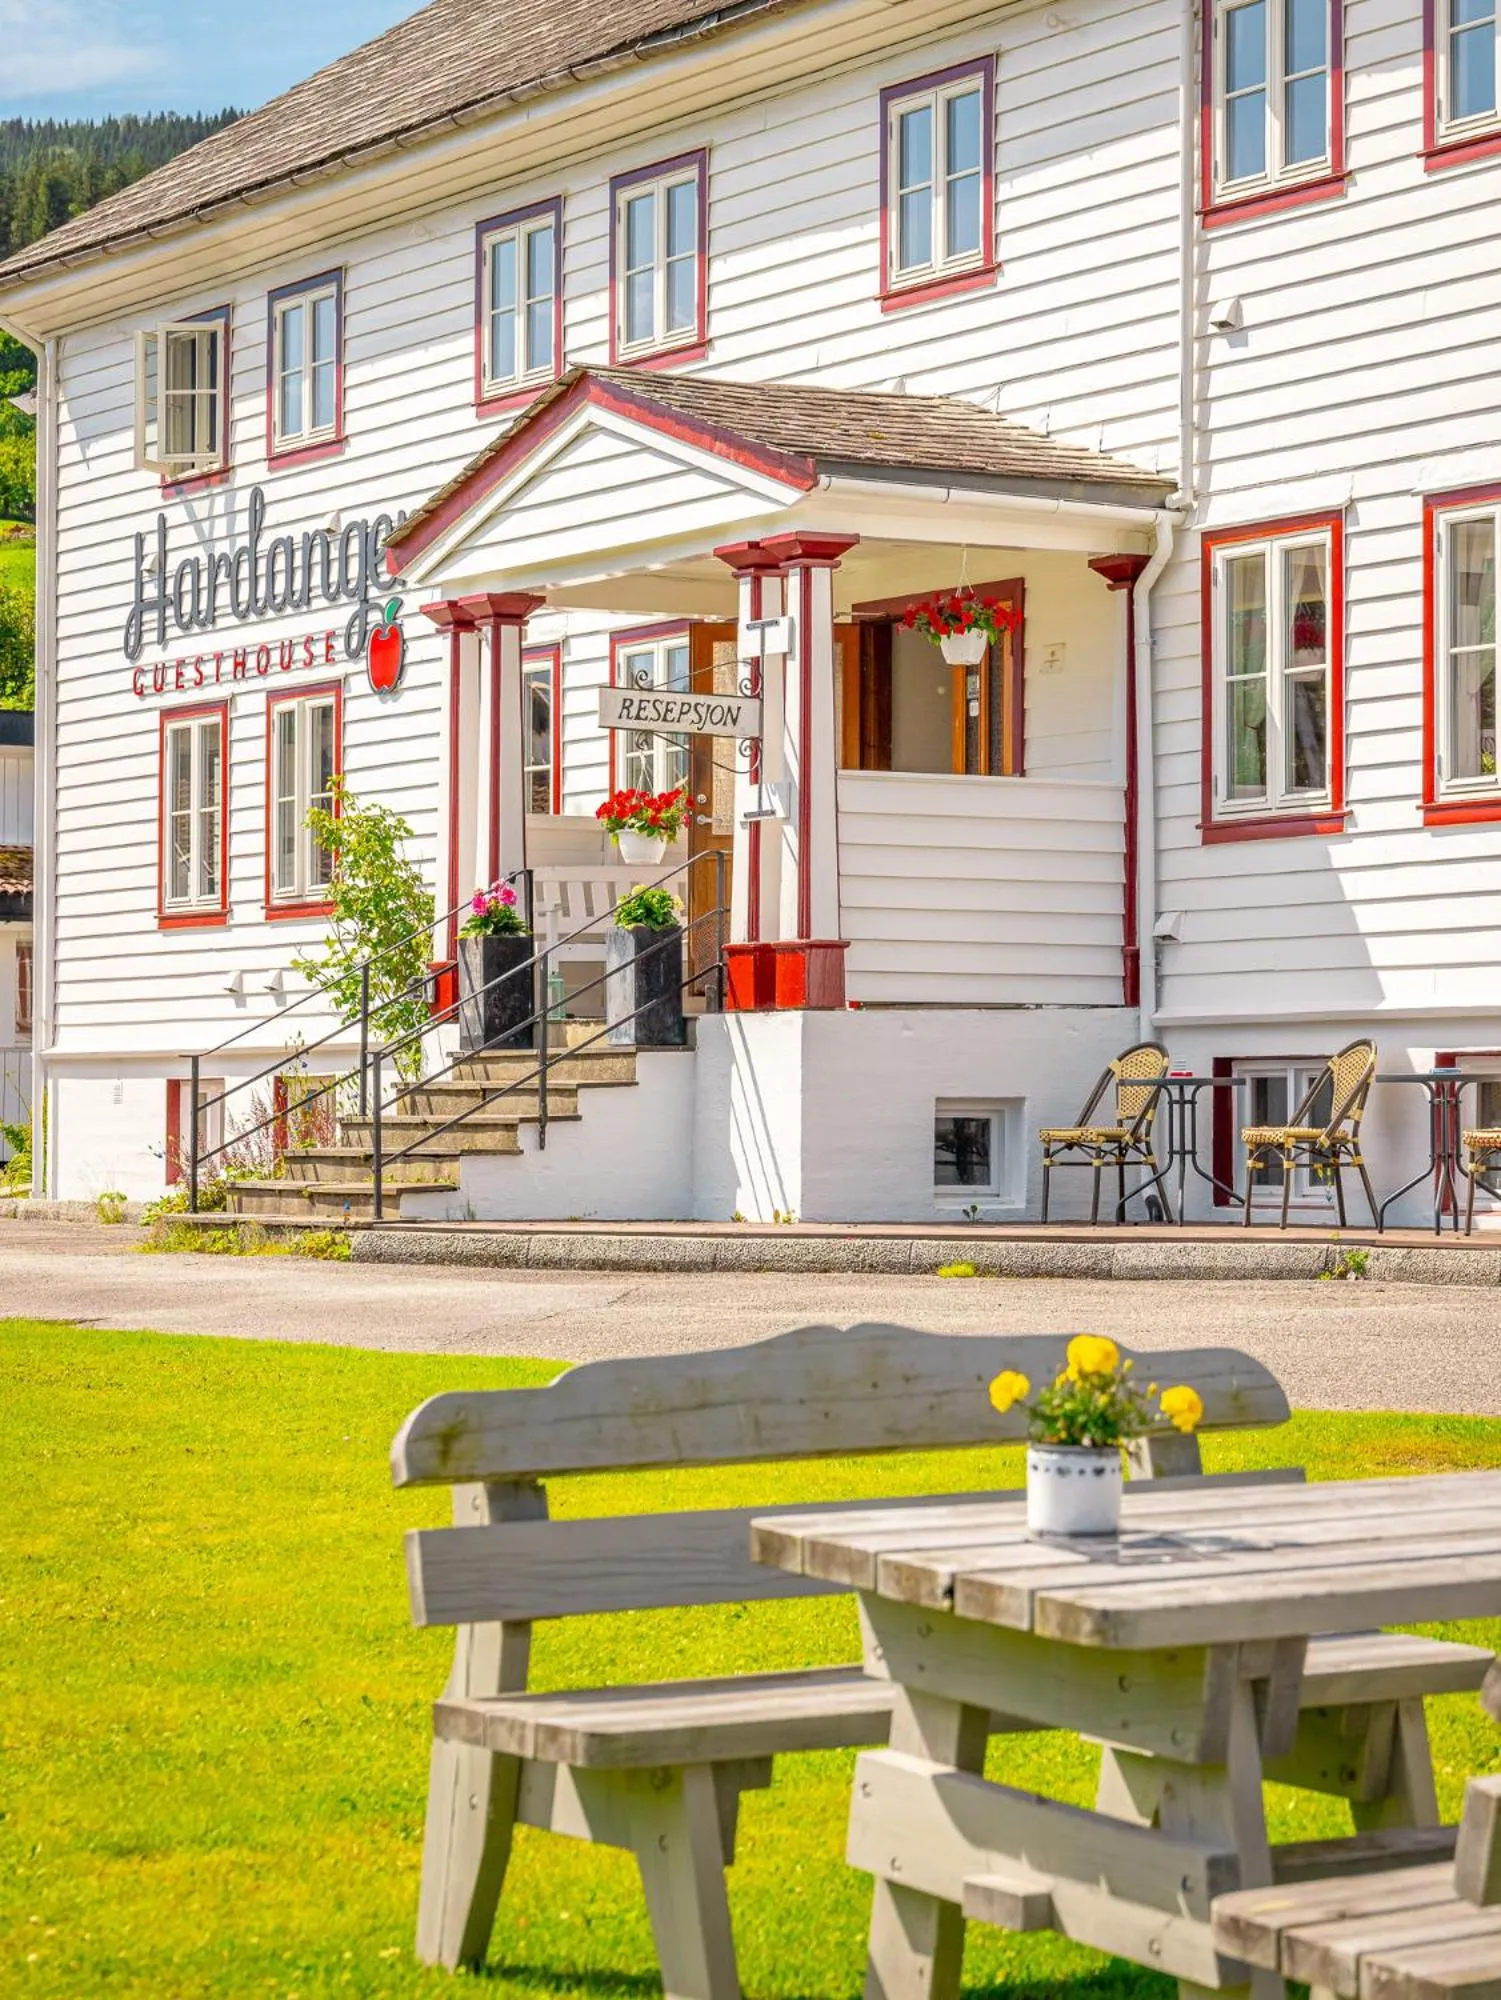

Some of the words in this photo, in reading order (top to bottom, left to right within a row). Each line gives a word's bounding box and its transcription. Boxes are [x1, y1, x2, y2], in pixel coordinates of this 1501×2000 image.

[124, 486, 418, 661] Hardange
[132, 630, 336, 697] GUESTHOUSE
[617, 697, 742, 731] RESEPSJON
